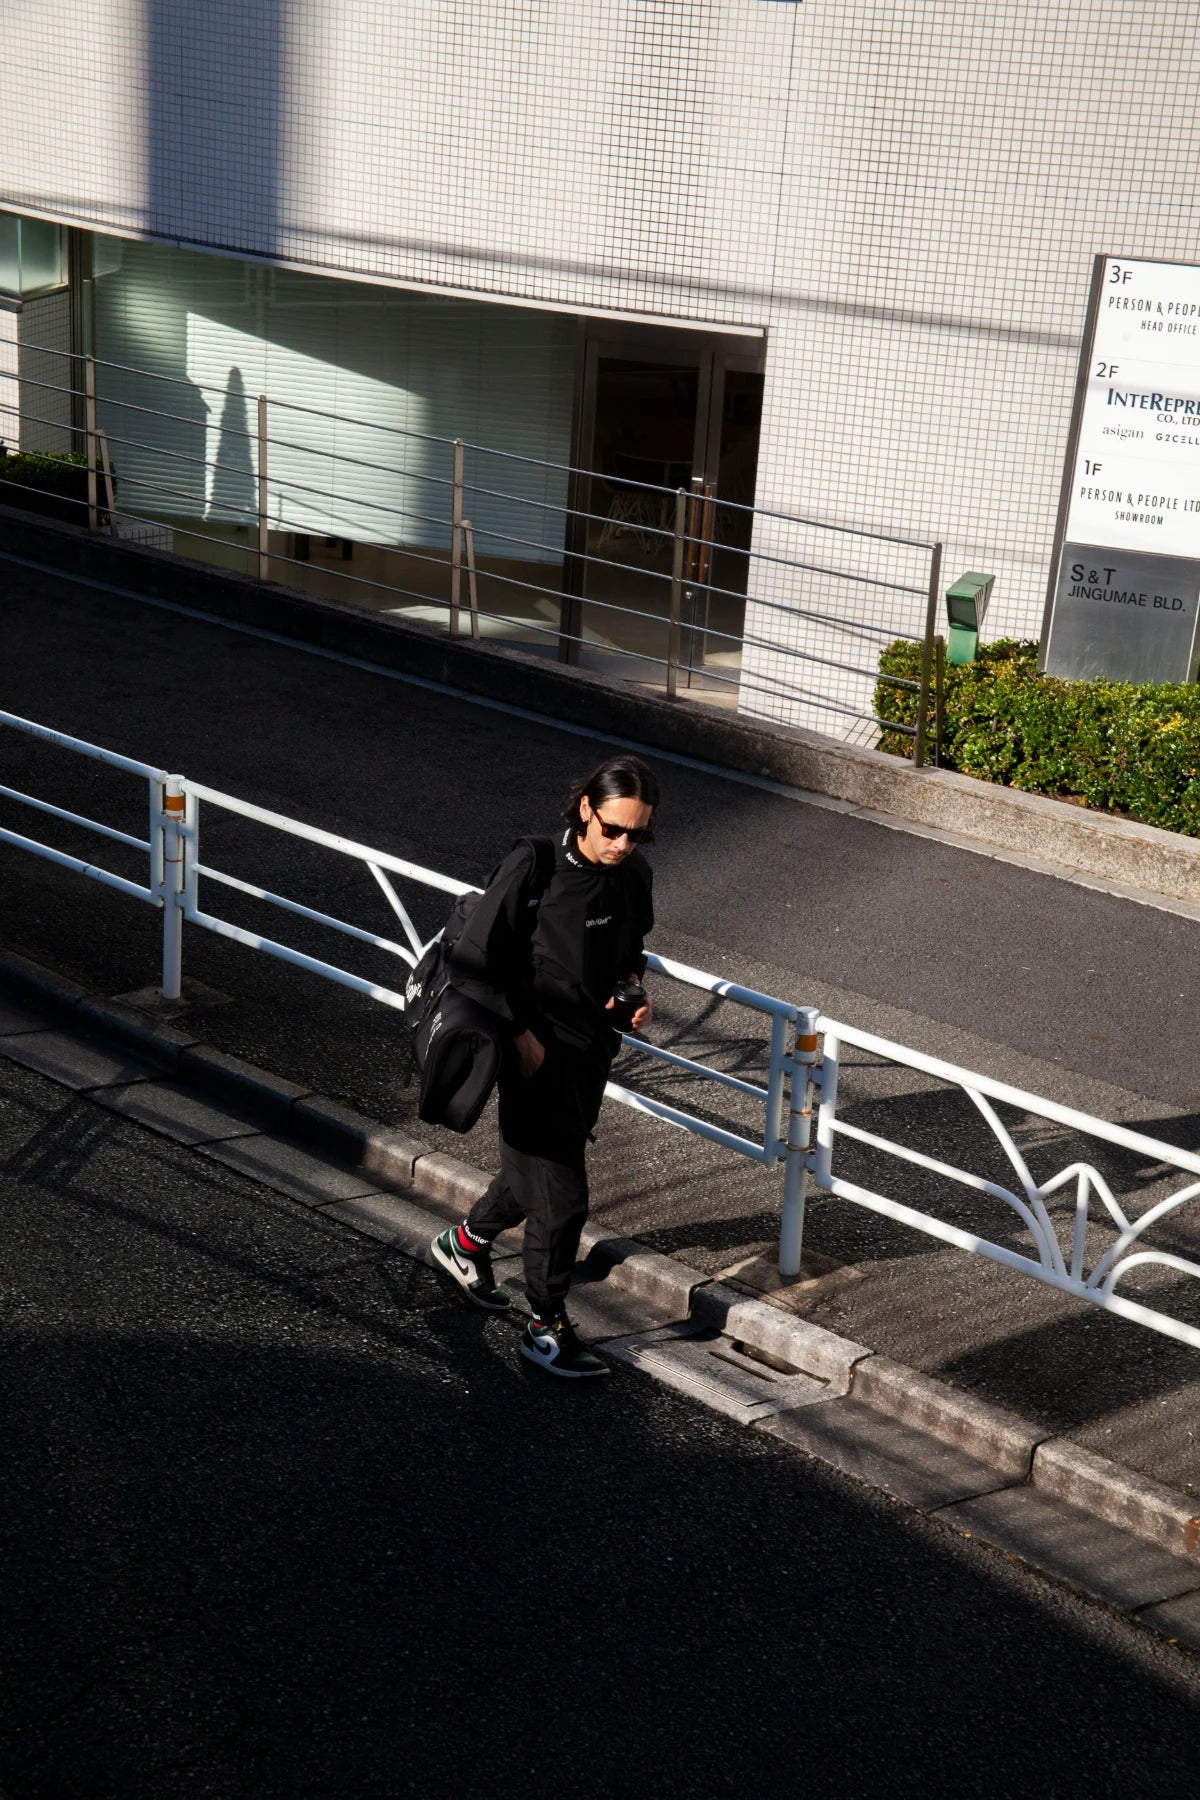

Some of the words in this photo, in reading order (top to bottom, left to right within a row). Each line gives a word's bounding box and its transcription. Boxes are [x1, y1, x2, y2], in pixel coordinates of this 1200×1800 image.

[1109, 265, 1133, 285] 3F
[1108, 296, 1152, 312] PERSON
[1156, 302, 1164, 316] &
[1140, 320, 1164, 332] HEAD
[1167, 322, 1198, 335] OFFICE
[1096, 362, 1119, 378] 2F
[1102, 424, 1144, 441] asigan
[1085, 460, 1102, 476] 1F
[1080, 487, 1122, 503] PERSON
[1126, 493, 1133, 507] &
[1137, 493, 1178, 510] PEOPLE
[1115, 510, 1163, 525] SHOWROOM
[1067, 585, 1148, 607] JINGUMAE
[1152, 595, 1186, 612] BLD.
